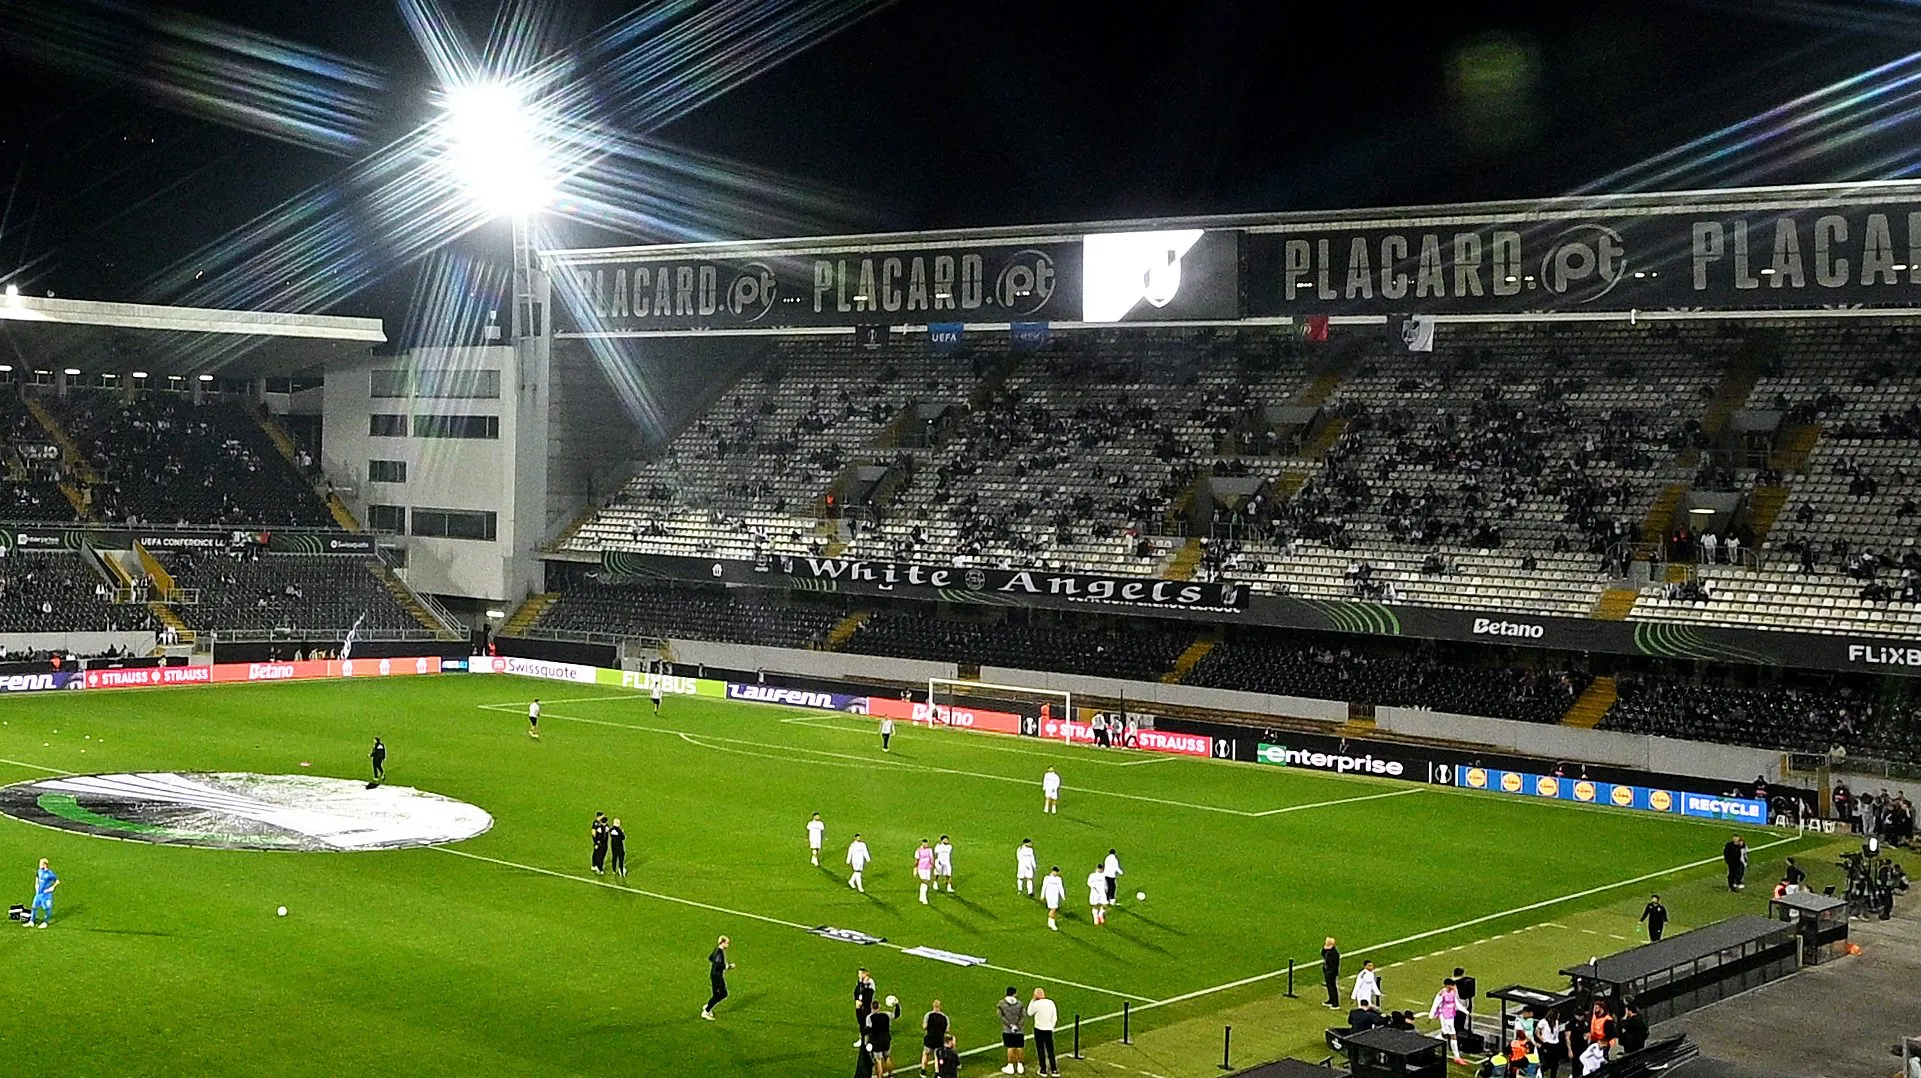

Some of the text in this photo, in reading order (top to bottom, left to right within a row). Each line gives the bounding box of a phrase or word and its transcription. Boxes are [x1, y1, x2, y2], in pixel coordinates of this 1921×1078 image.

[932, 333, 957, 342] UEFA
[806, 559, 951, 587] White
[999, 571, 1201, 603] Angels
[1473, 618, 1543, 638] Betano
[101, 668, 208, 685] STRAUSS STRAUSS
[250, 664, 294, 680] Betano
[508, 659, 577, 679] Swissquote
[1140, 733, 1205, 753] STRAUSS
[1266, 746, 1404, 775] enterprise
[1689, 797, 1759, 817] RECYCLE
